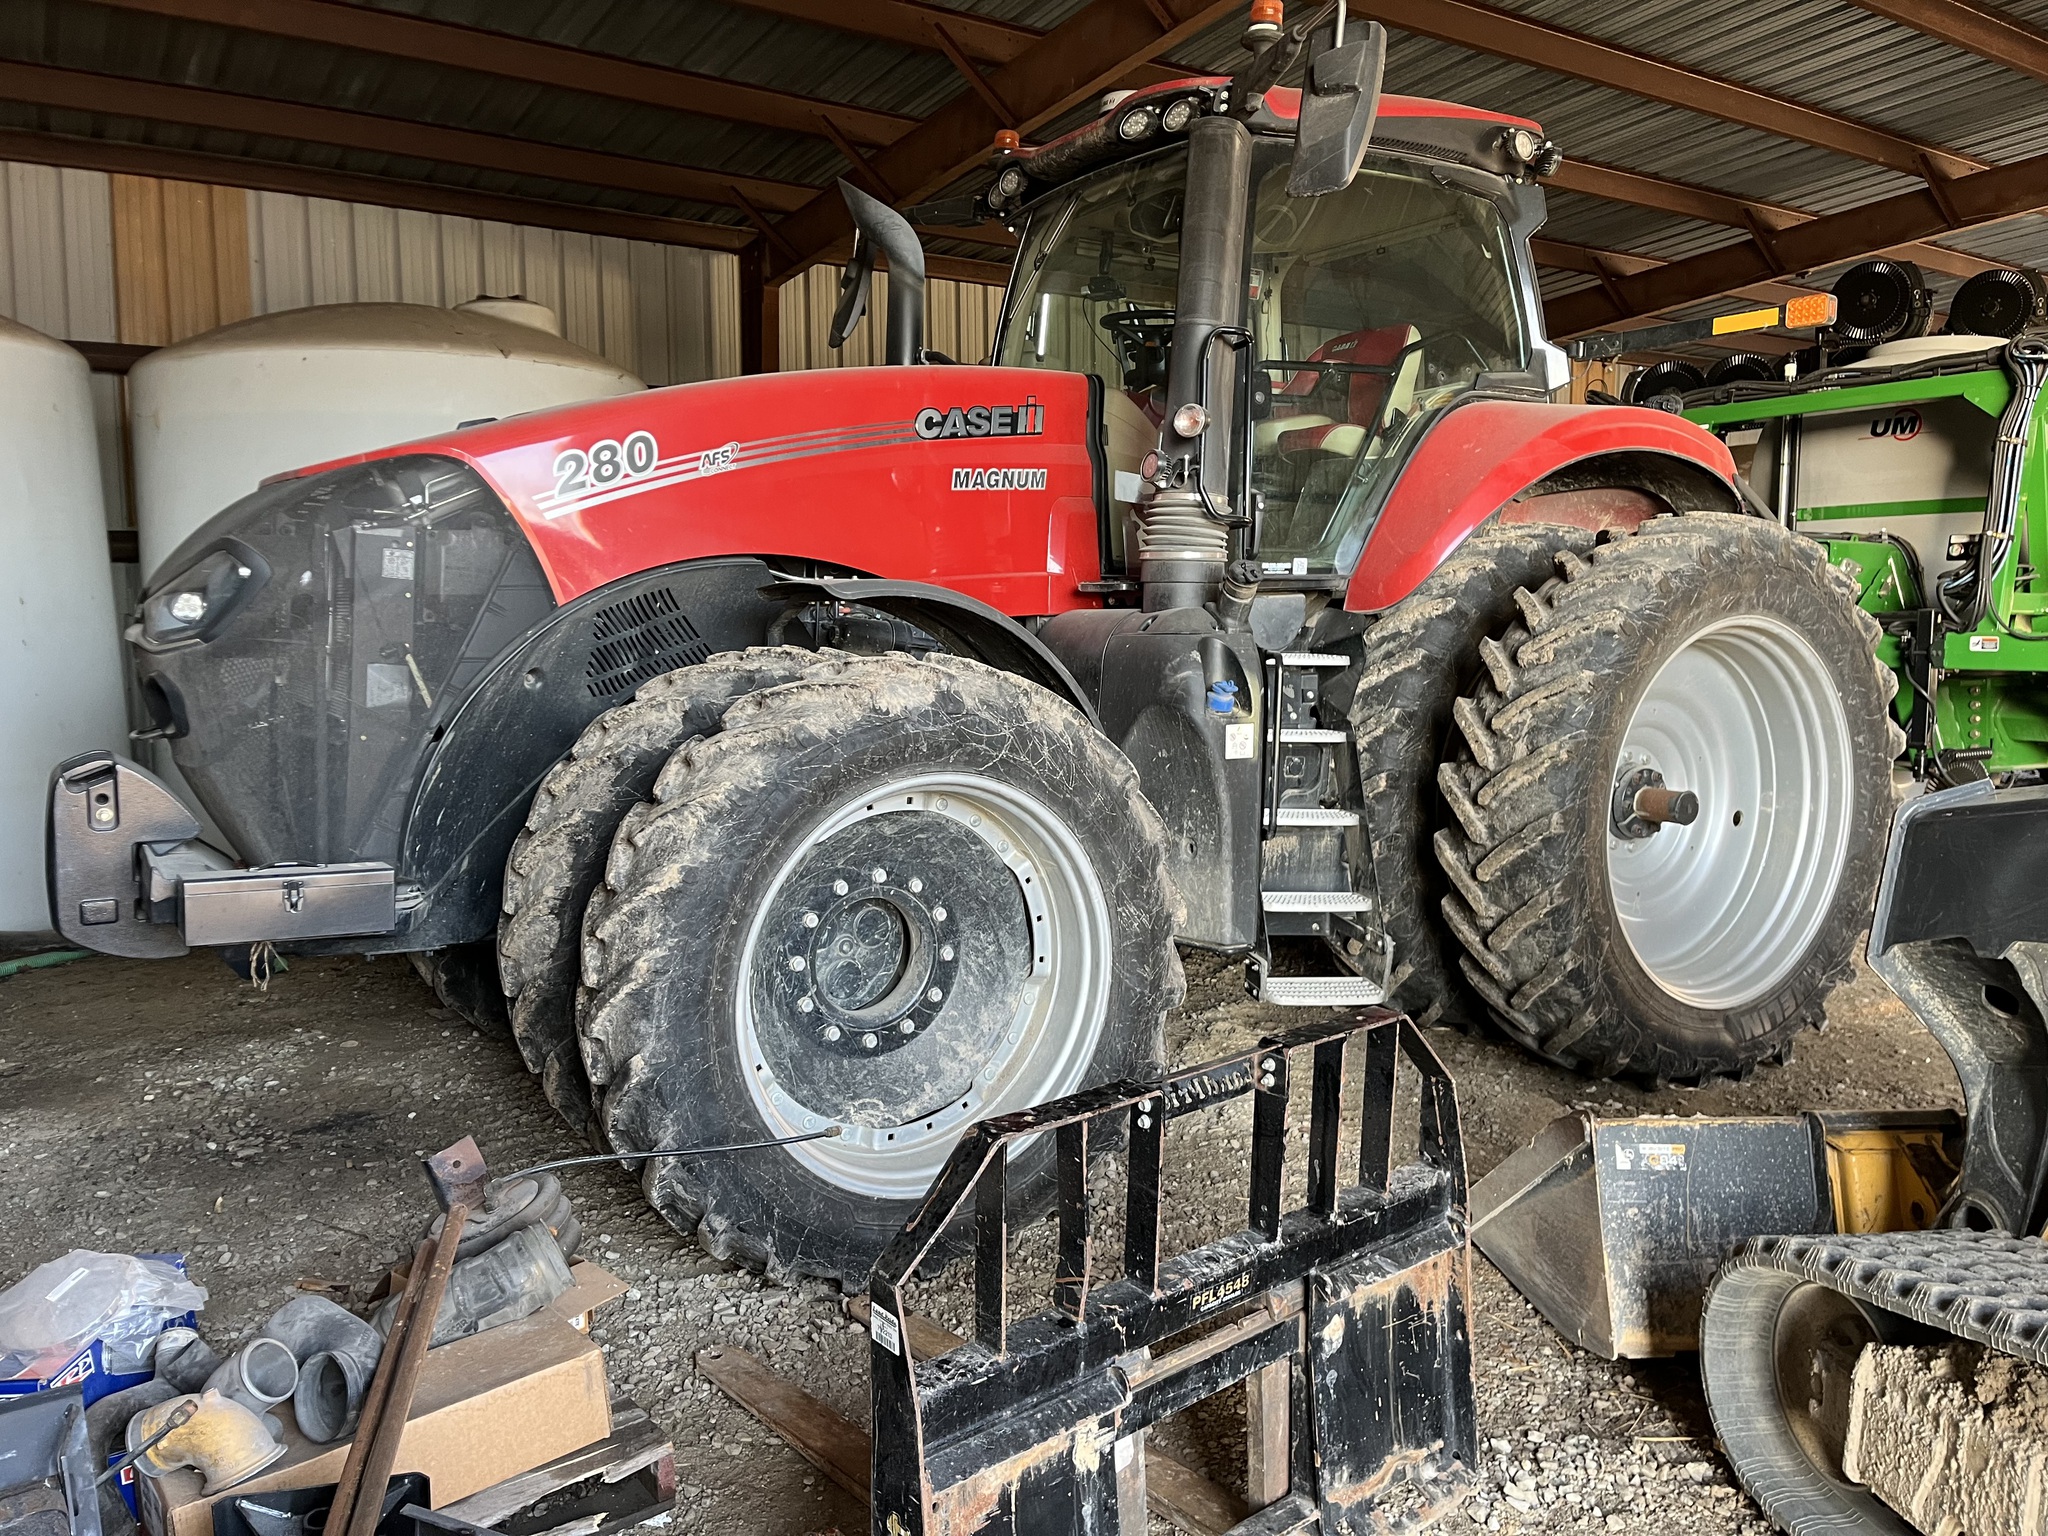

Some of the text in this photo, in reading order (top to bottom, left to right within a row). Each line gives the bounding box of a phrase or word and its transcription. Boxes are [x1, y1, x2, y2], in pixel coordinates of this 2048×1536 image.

[1870, 415, 1919, 438] UM
[553, 430, 658, 498] 280
[702, 448, 731, 469] AFS
[952, 469, 1046, 490] MAGNUM
